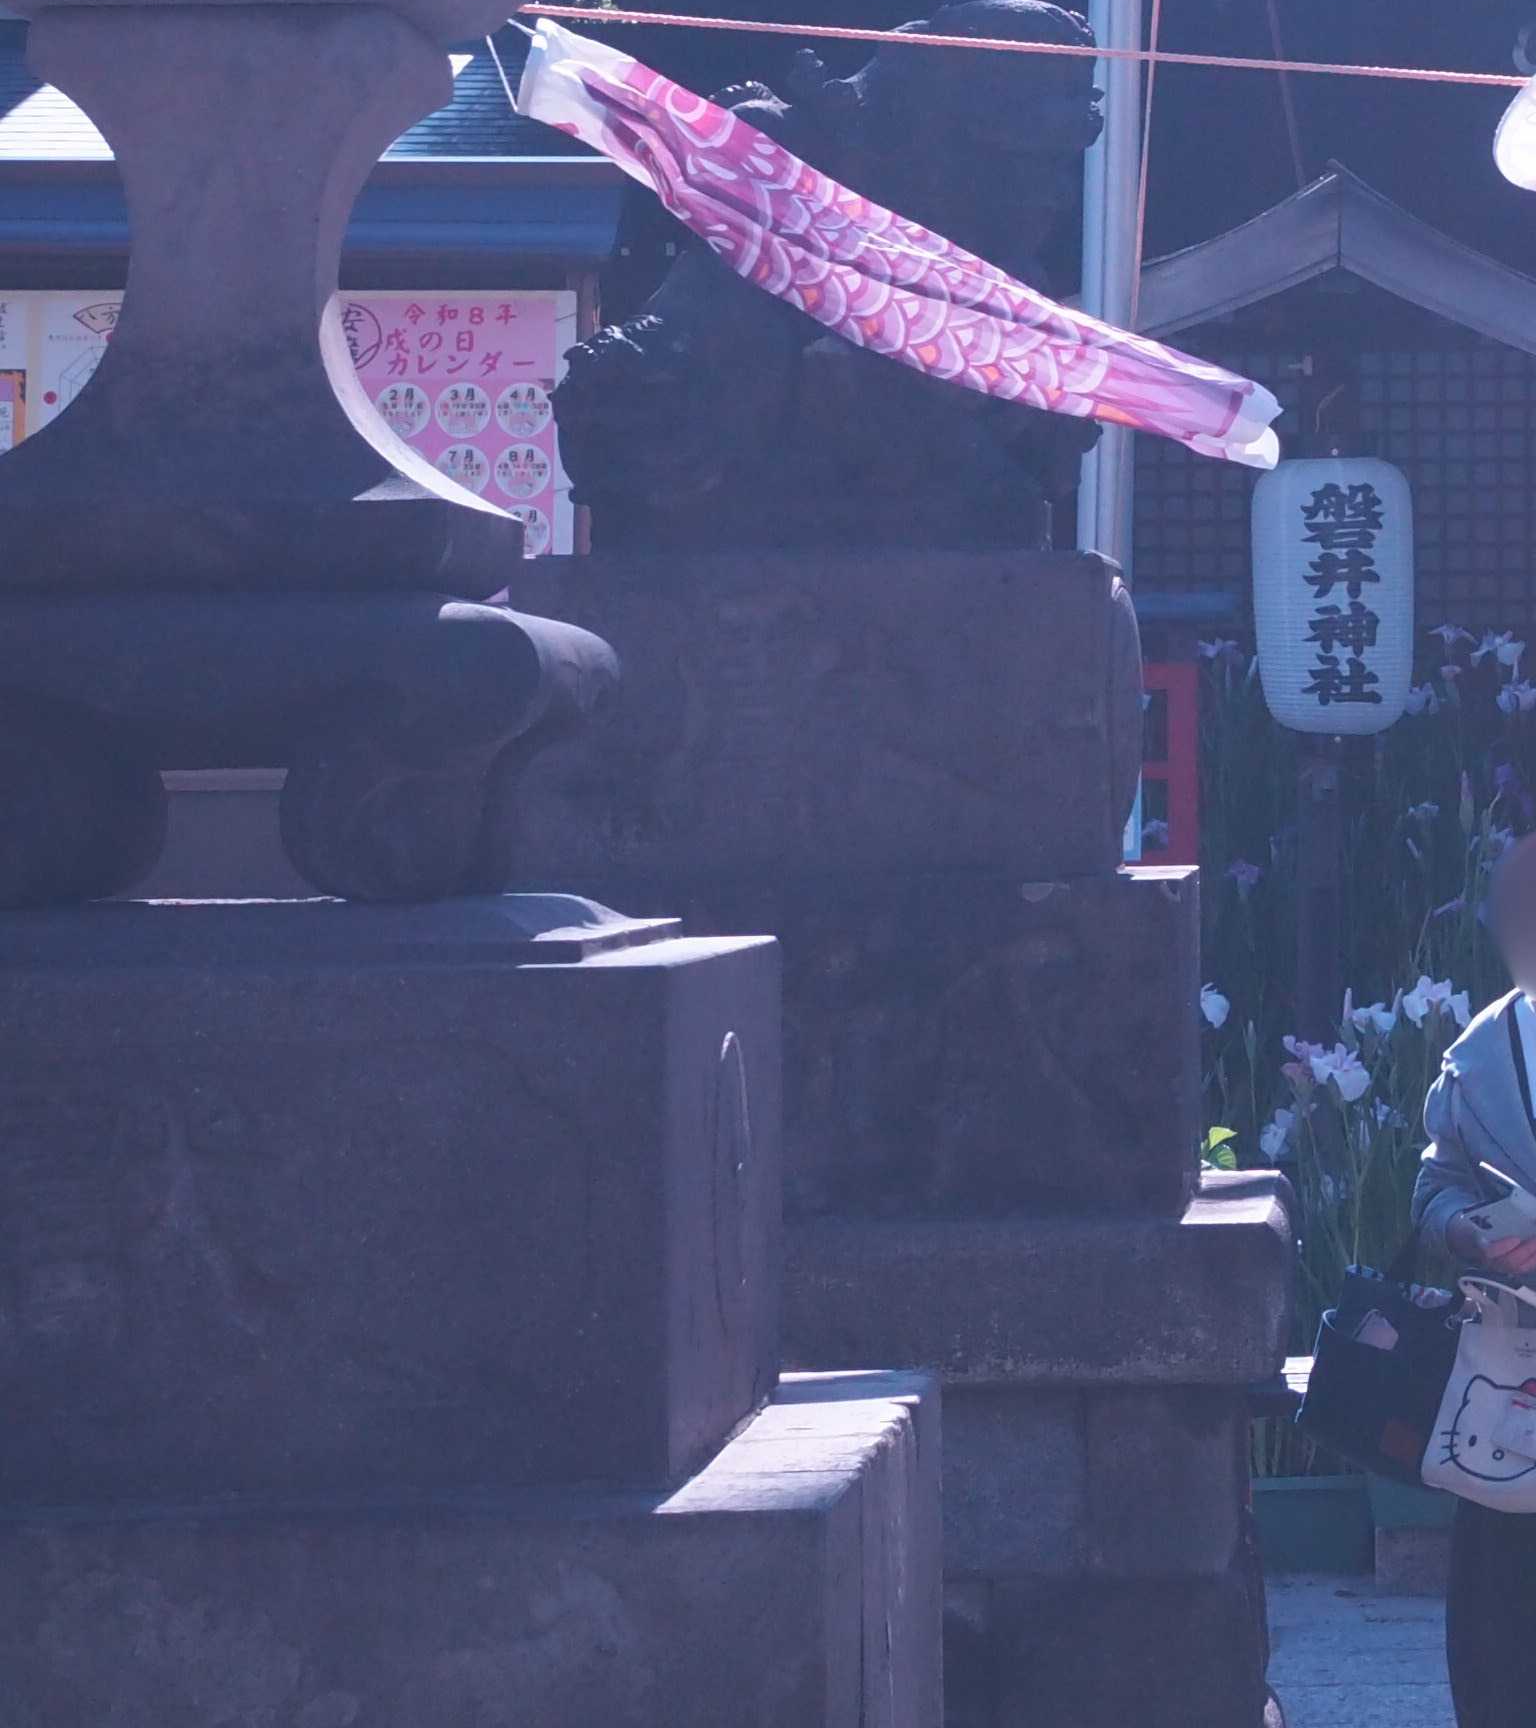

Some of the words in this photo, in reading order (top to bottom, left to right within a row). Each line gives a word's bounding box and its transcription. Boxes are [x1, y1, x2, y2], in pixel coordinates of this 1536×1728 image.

[404, 303, 518, 325] 令和8年
[385, 328, 475, 352] 戌の日
[386, 351, 536, 377] カレンダー
[389, 387, 415, 402] 2月
[450, 387, 476, 401] 3月
[510, 387, 536, 401] 4月
[449, 449, 475, 463] 7月
[509, 449, 535, 463] 8月
